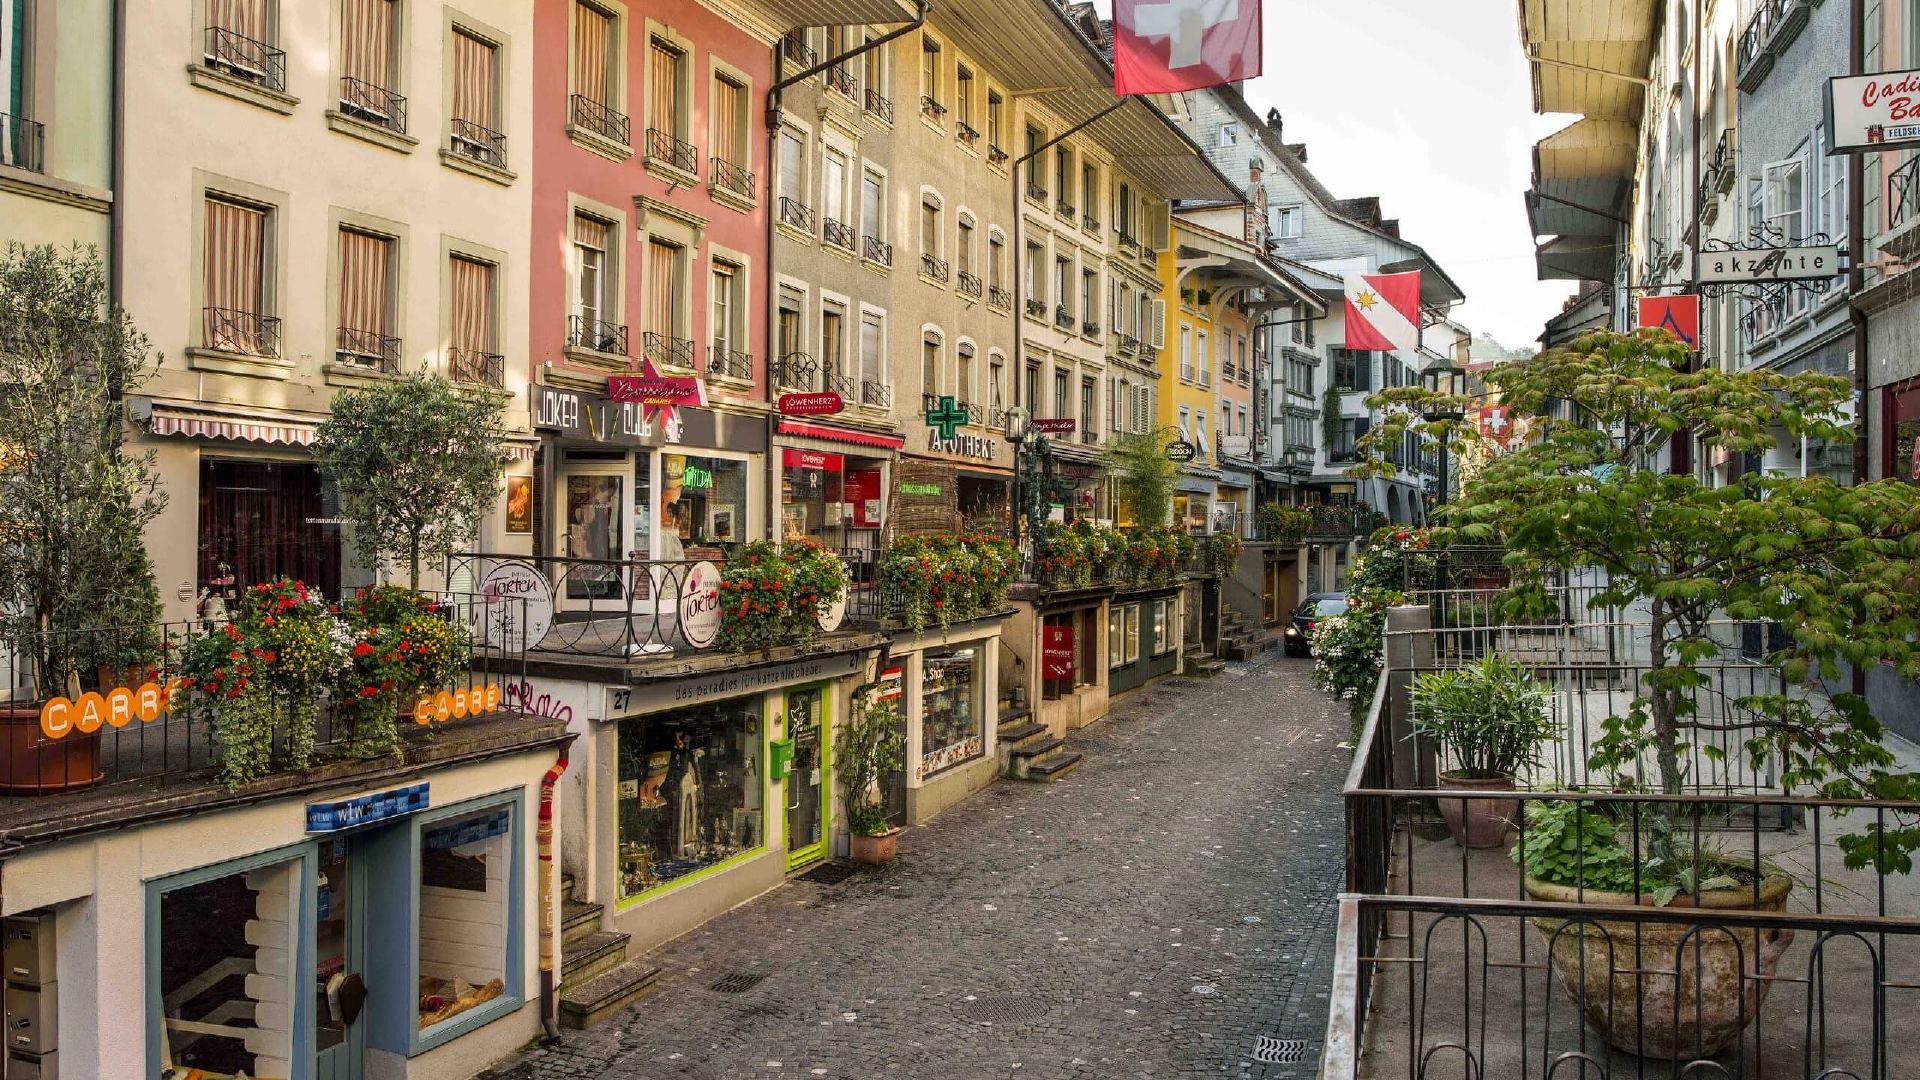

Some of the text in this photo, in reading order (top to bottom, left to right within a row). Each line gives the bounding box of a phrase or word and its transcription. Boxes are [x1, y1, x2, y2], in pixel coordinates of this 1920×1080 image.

[537, 390, 578, 428] JOKER
[928, 427, 996, 459] APOTHEKE
[489, 576, 537, 596] Torten
[675, 663, 823, 701] das paradies für katzenliebhaber
[418, 685, 496, 719] CARRÉ
[613, 691, 631, 713] 27
